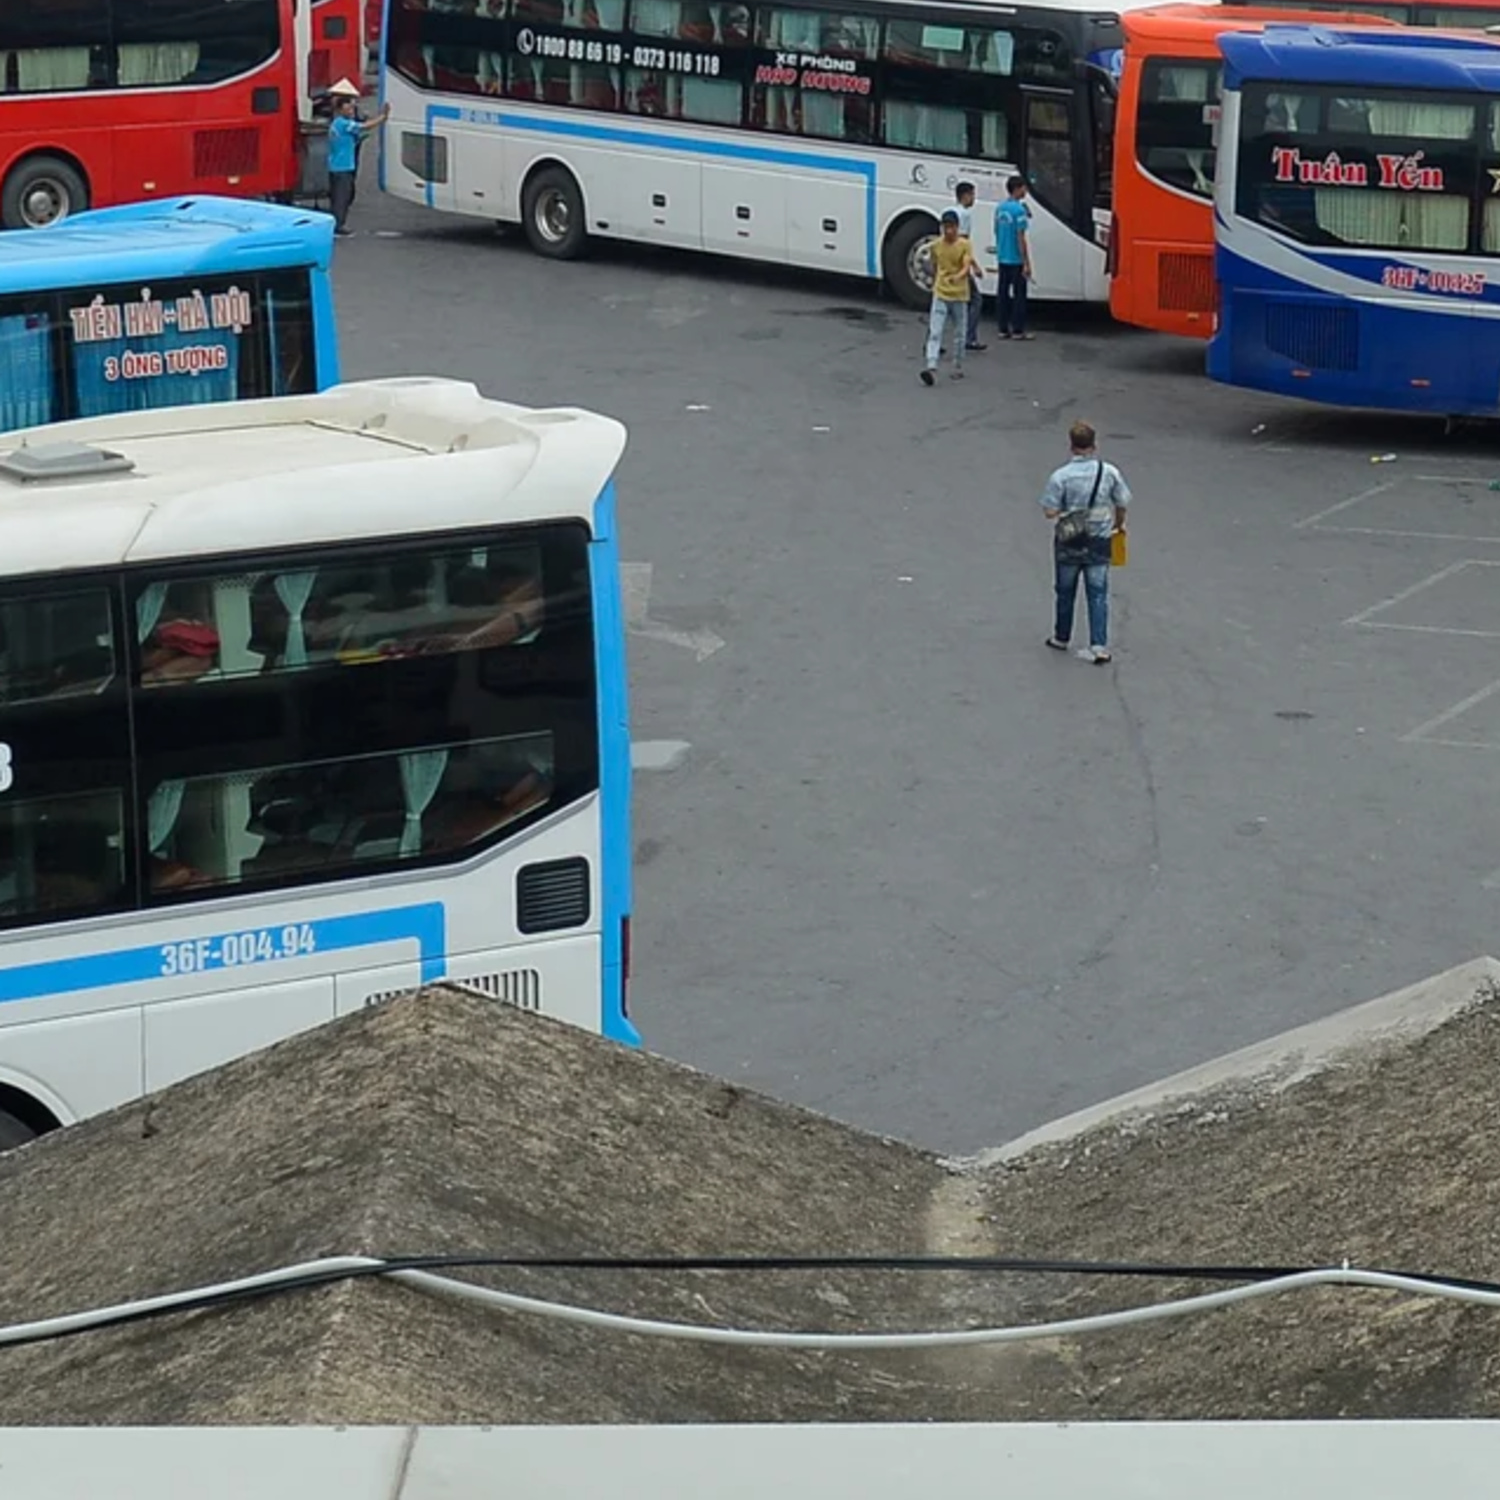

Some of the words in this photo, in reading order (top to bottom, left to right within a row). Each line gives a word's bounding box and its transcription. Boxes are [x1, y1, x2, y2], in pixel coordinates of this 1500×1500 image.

[1376, 150, 1444, 190] Yến
[176, 289, 209, 332] HÀ
[211, 285, 251, 334] NỘI
[104, 356, 119, 380] 3
[160, 923, 316, 976] 36F-004.94
